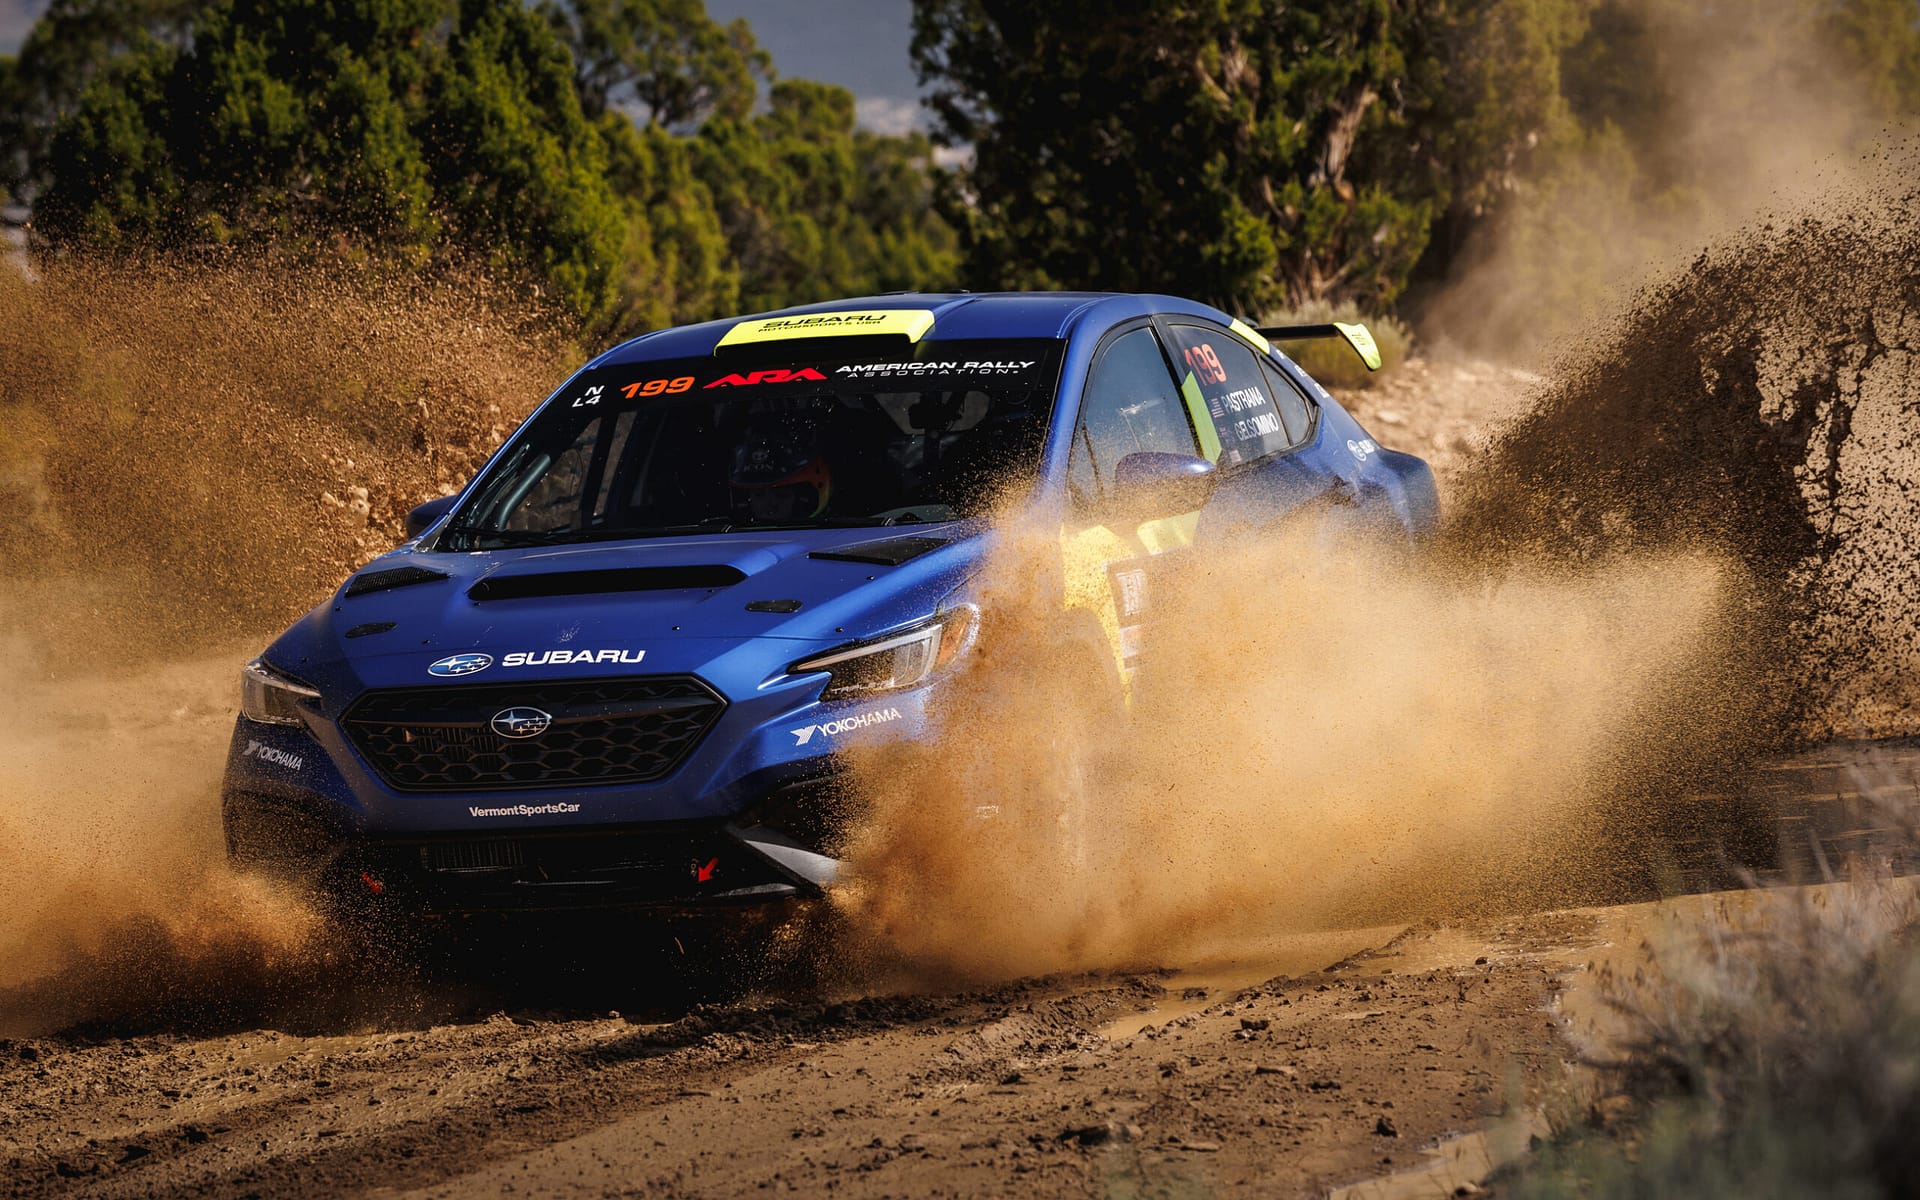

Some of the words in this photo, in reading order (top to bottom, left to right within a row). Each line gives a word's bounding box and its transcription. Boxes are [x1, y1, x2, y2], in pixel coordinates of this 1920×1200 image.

[758, 321, 852, 332] MOTORSPORTS
[763, 314, 887, 328] SUBARU
[835, 361, 957, 373] AMERICAN
[963, 361, 1036, 369] RALLY
[847, 368, 1010, 378] ASSOCIATION
[1184, 343, 1227, 386] 199
[620, 376, 695, 399] 199
[703, 368, 827, 389] ARA
[584, 385, 605, 396] N
[572, 395, 602, 408] L4
[1221, 386, 1266, 414] PASTRANA
[1234, 412, 1279, 440] GELSOMINO
[502, 649, 646, 667] SUBARU
[817, 707, 902, 737] YOKOHAMA
[257, 744, 302, 770] YOKOHAMA
[469, 802, 580, 817] VermontSportsCar
